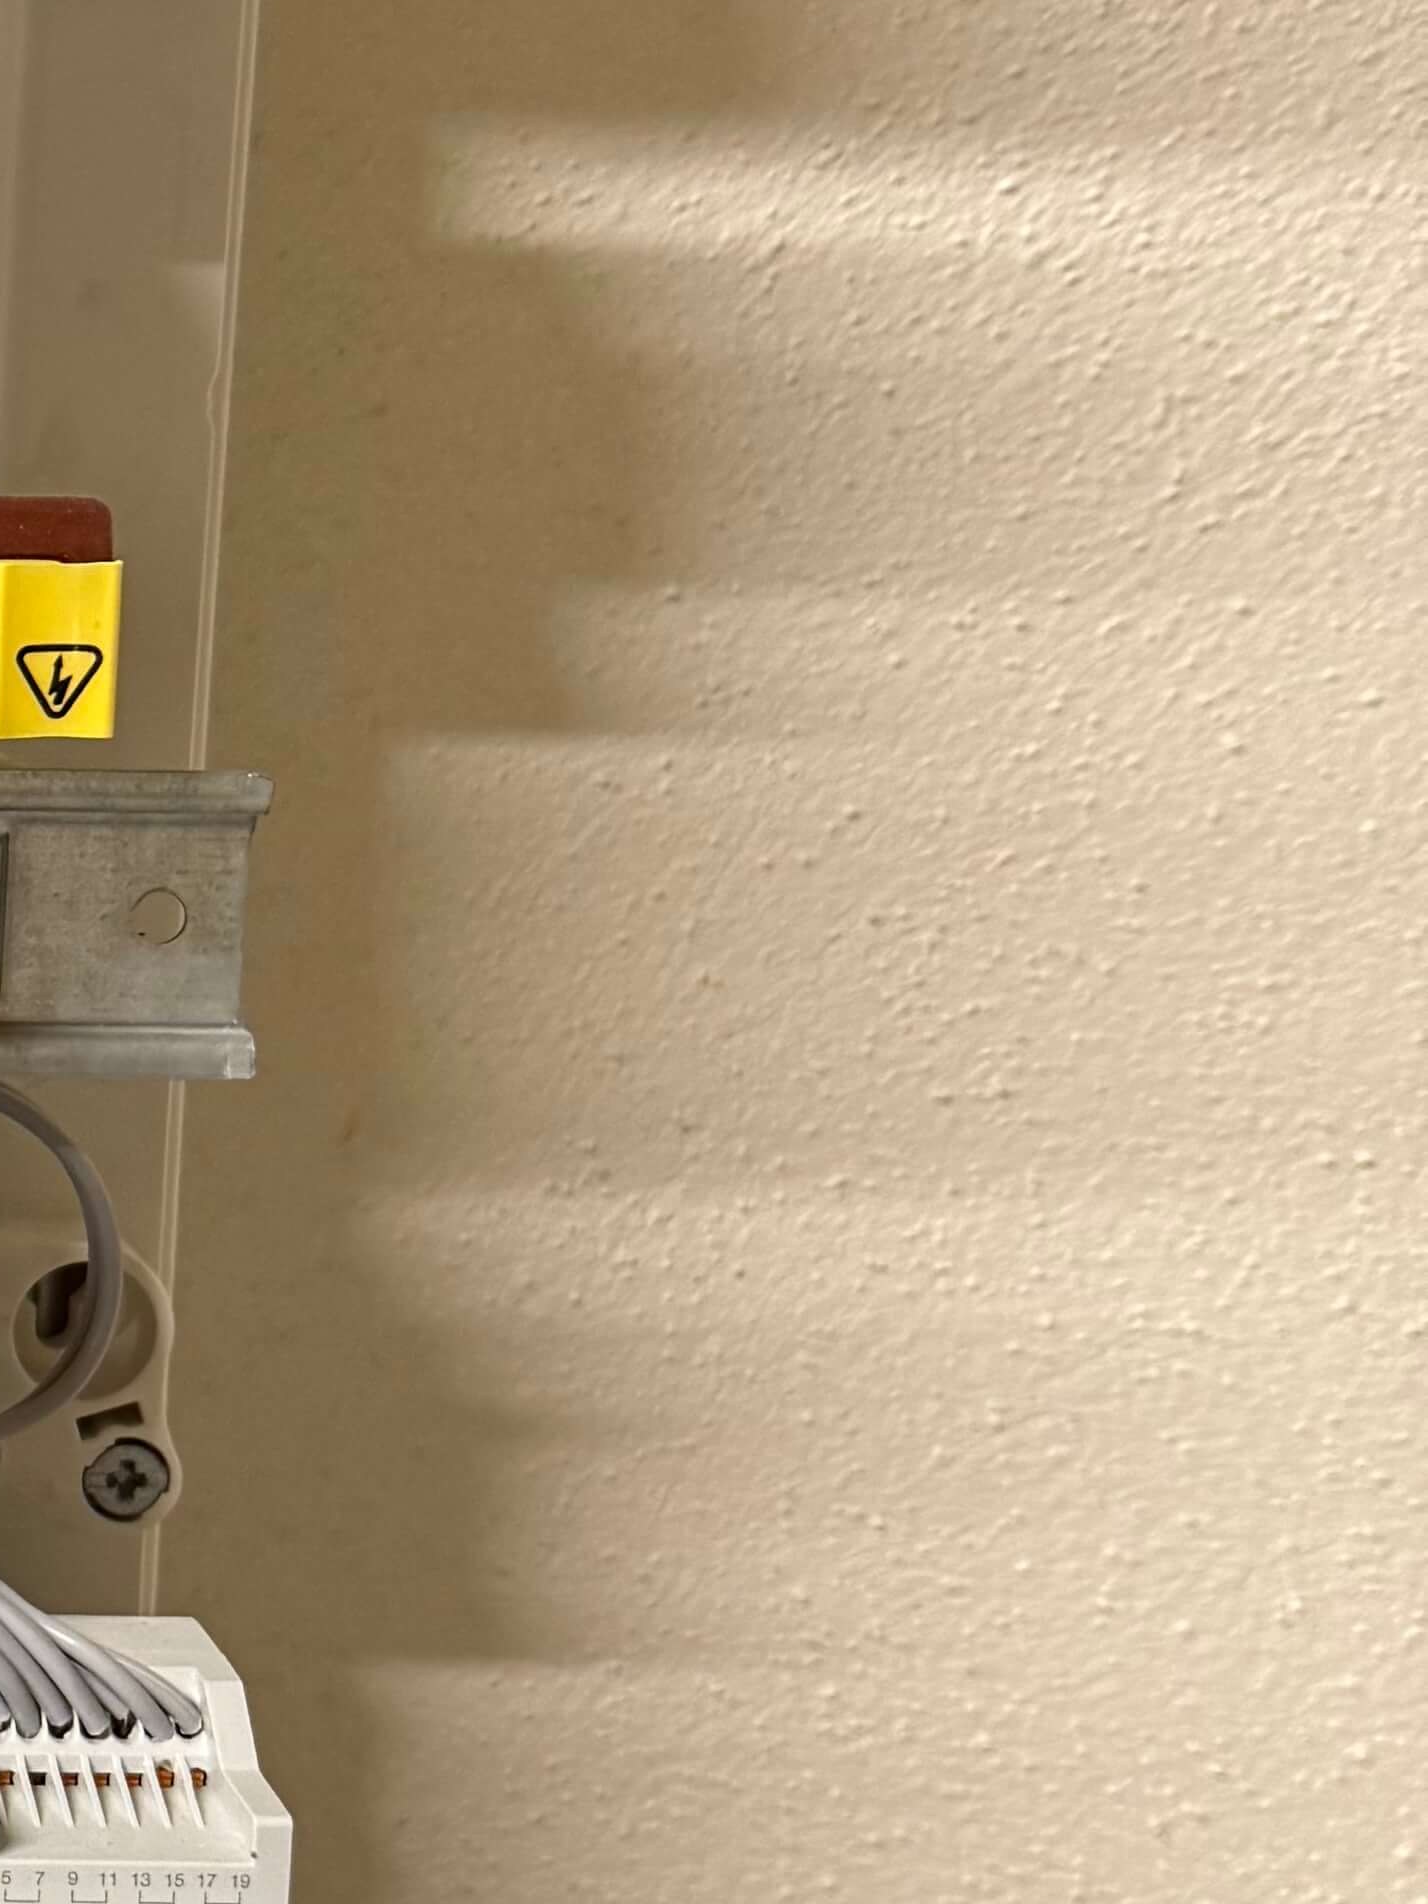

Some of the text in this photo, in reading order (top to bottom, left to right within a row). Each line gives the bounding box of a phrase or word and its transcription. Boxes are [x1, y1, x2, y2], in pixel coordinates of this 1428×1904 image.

[2, 1872, 251, 1889] 5 7 9 11 13 15 17 19
